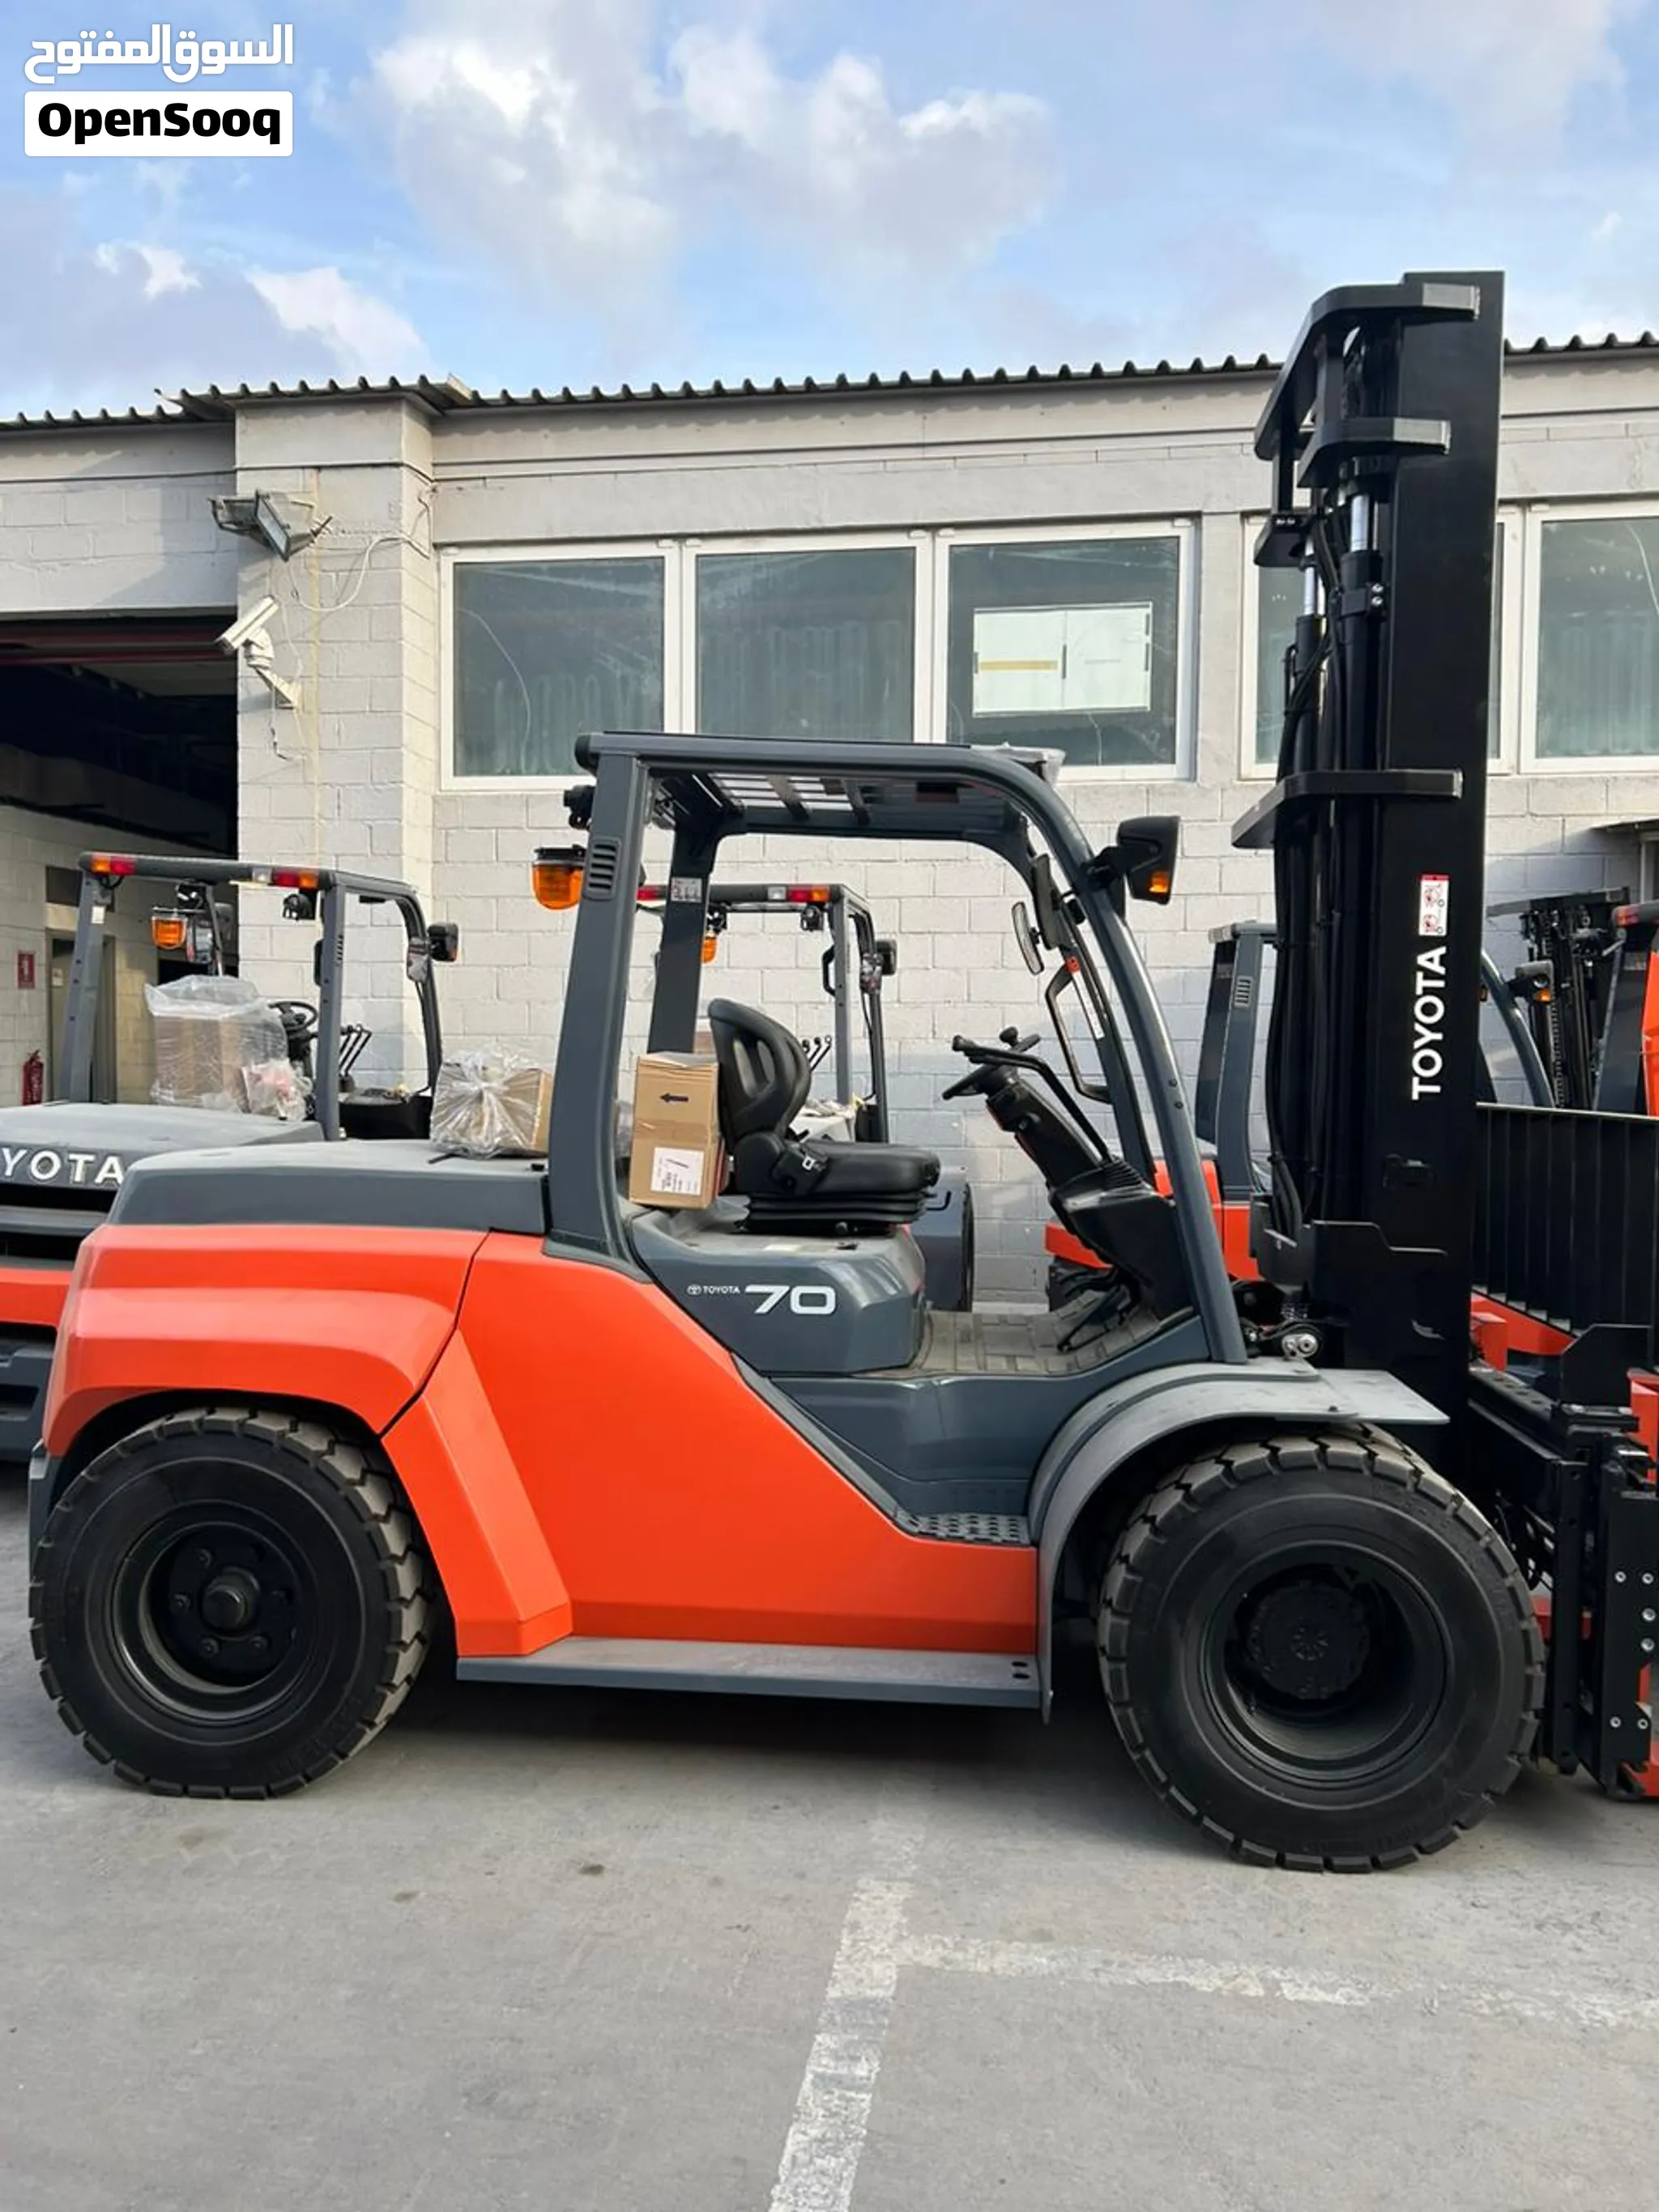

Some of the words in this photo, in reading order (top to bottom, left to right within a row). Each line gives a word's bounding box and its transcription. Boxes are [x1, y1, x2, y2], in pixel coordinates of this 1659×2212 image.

[1411, 945, 1447, 1100] TOYOTA
[2, 1147, 124, 1184] YOTA
[702, 1285, 740, 1294] TOYOTA
[744, 1285, 836, 1315] 70
